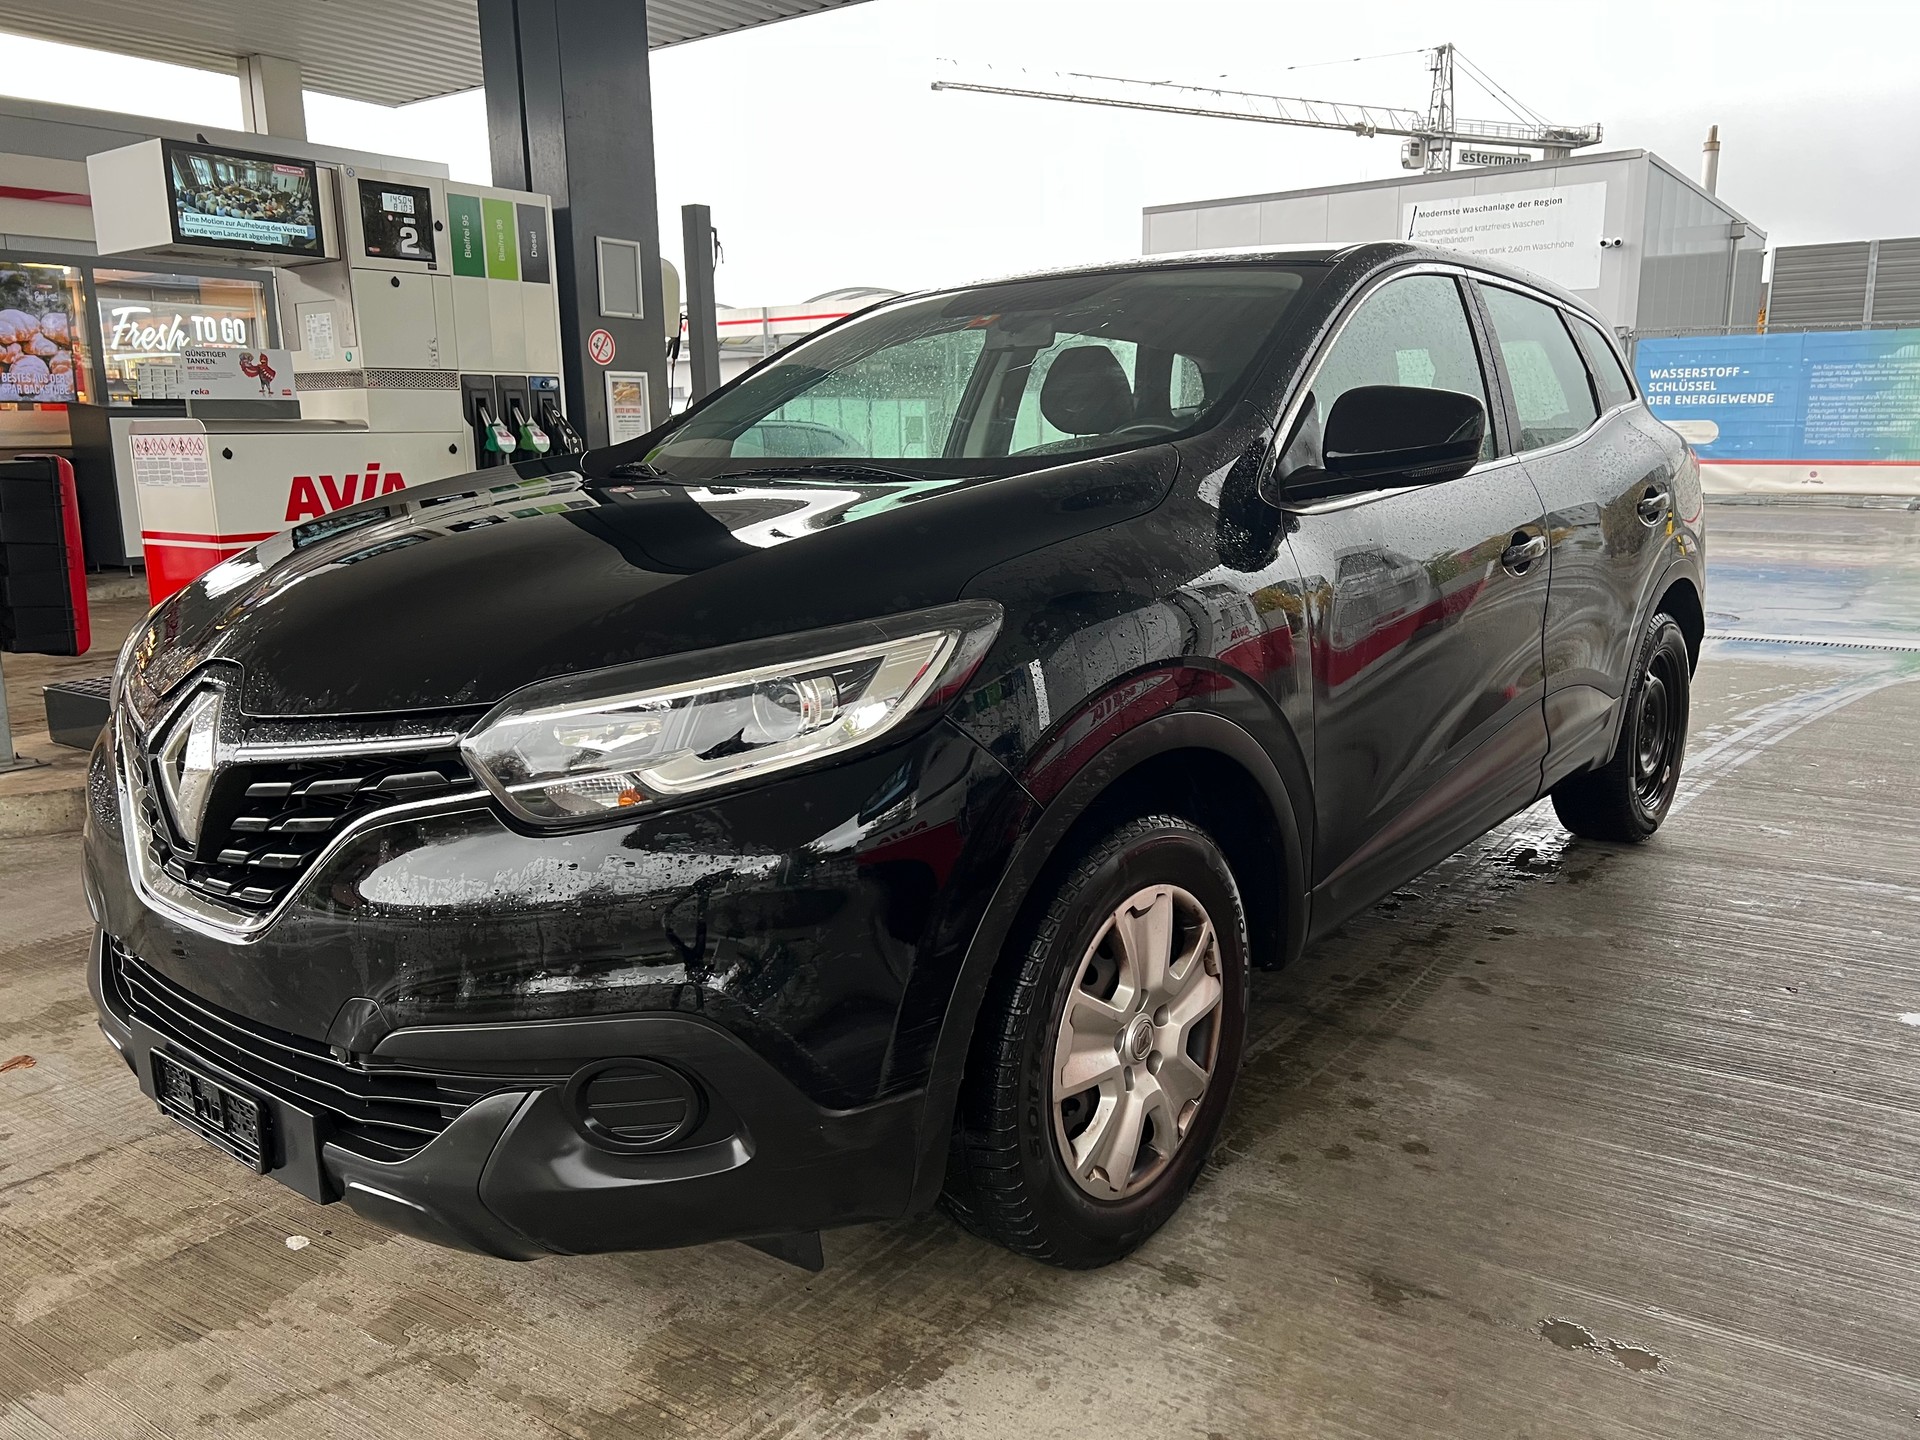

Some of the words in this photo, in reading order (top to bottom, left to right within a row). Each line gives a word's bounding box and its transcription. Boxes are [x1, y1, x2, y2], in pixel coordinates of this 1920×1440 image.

[1461, 152, 1529, 165] estermann
[1418, 208, 1461, 218] Modernste
[1462, 202, 1515, 214] Waschanlage
[1517, 200, 1532, 209] der
[1533, 198, 1563, 207] Region
[185, 214, 200, 223] Eine
[200, 217, 225, 225] Motion
[236, 220, 270, 231] Aufhebung
[281, 225, 307, 235] Verbots
[461, 214, 470, 227] 95
[1459, 225, 1474, 234] und
[1511, 219, 1546, 229] Waschen
[223, 229, 249, 239] Landrat
[248, 232, 281, 242] abgelehnt.
[399, 226, 420, 255] 2
[464, 228, 472, 258] Bleifrei
[529, 231, 538, 258] Diesel
[1532, 240, 1576, 251] Waschhöhe
[111, 306, 191, 351] Fresh
[191, 315, 217, 343] TO
[221, 317, 247, 344] GO
[184, 349, 228, 358] GÜNSTIGER
[186, 357, 218, 365] TANKEN.
[1, 373, 32, 384] BESTES
[1650, 367, 1740, 379] WASSERSTOFF
[190, 387, 210, 396] reka
[1648, 379, 1717, 393] SCHLÜSSEL
[1647, 395, 1671, 406] DER
[1674, 393, 1775, 405] ENERGIEWENDE
